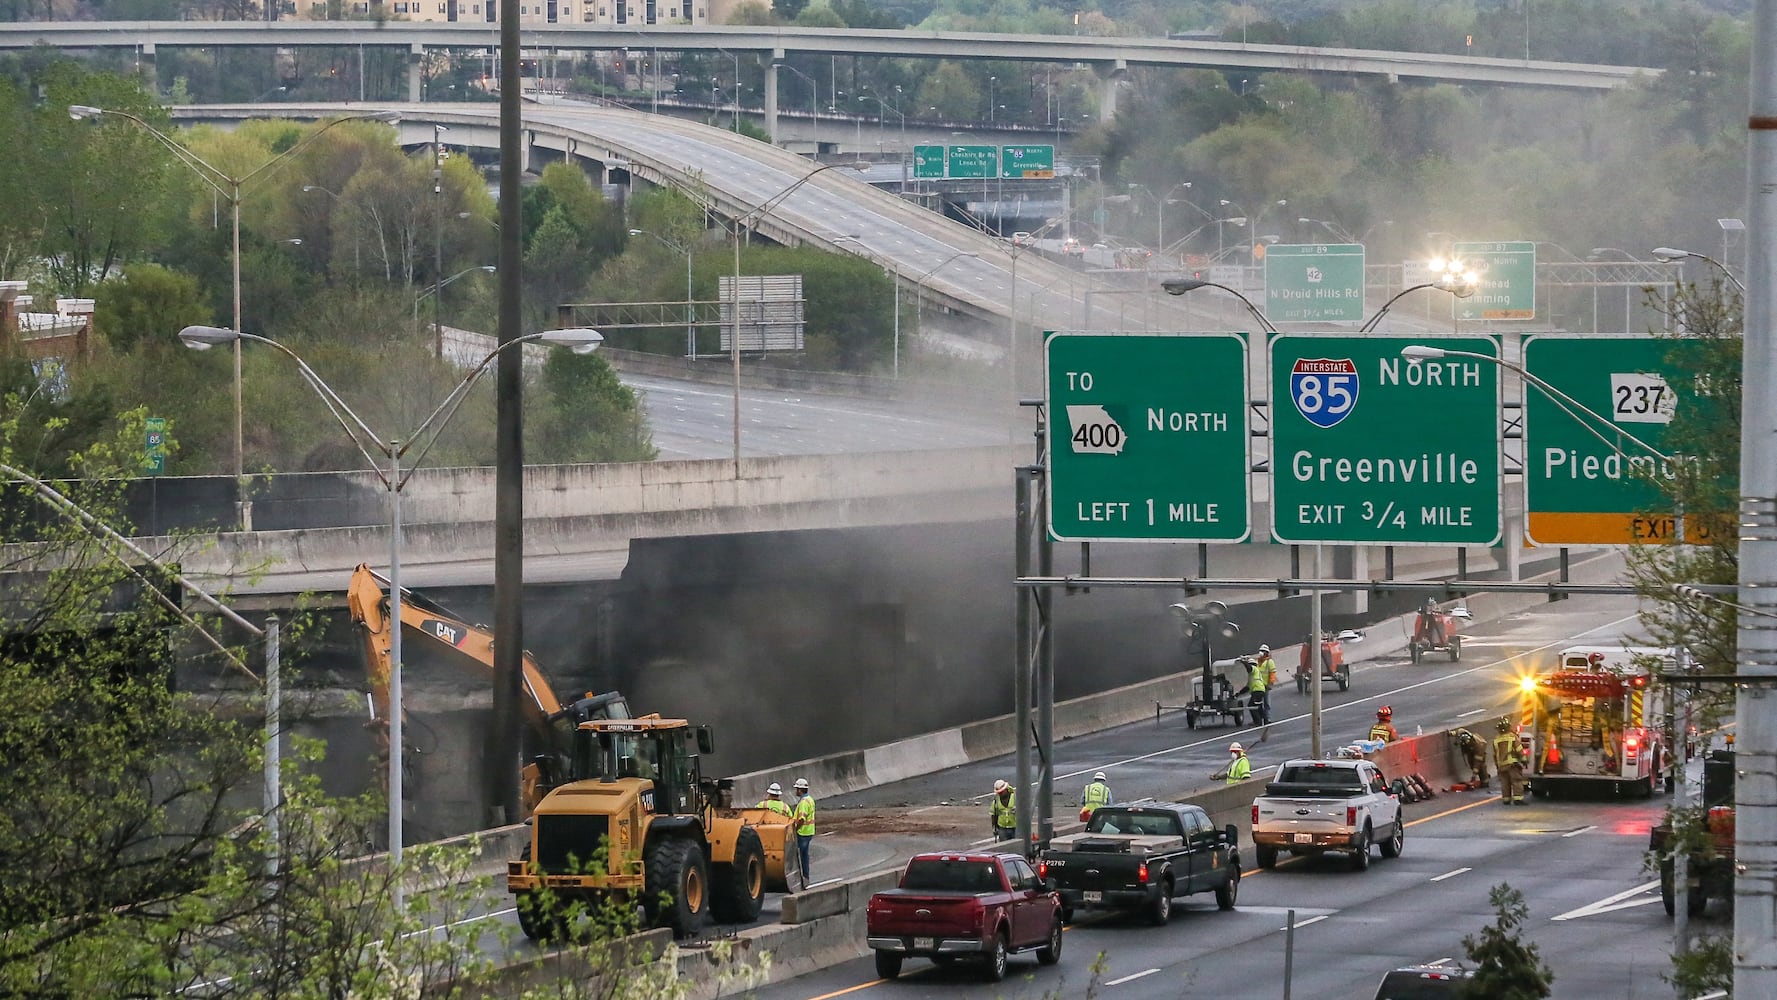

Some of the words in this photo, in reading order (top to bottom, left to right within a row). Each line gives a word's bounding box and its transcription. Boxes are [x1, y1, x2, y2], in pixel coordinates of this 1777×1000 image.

[1316, 246, 1328, 254] 89
[1496, 243, 1507, 251] 87
[1308, 270, 1320, 279] 42
[1271, 289, 1278, 298] N
[1282, 288, 1311, 299] Druid
[1315, 288, 1341, 298] Hills
[1345, 288, 1359, 298] Rd
[1301, 362, 1348, 373] INTERSTATE
[1066, 372, 1094, 391] TO
[1299, 375, 1352, 414] 85
[1379, 357, 1480, 387] NORTH
[1616, 385, 1665, 414] 237
[1073, 423, 1120, 448] 400
[1147, 408, 1227, 432] NORTH
[150, 435, 160, 443] 85
[1292, 450, 1478, 484] Greenville
[1078, 502, 1130, 521] LEFT
[1146, 498, 1154, 526] 1
[1169, 503, 1219, 522] MILE
[1298, 504, 1345, 524] EXIT
[1361, 501, 1406, 529] 3/4
[1421, 506, 1473, 526] MILE
[436, 622, 456, 644] CAT
